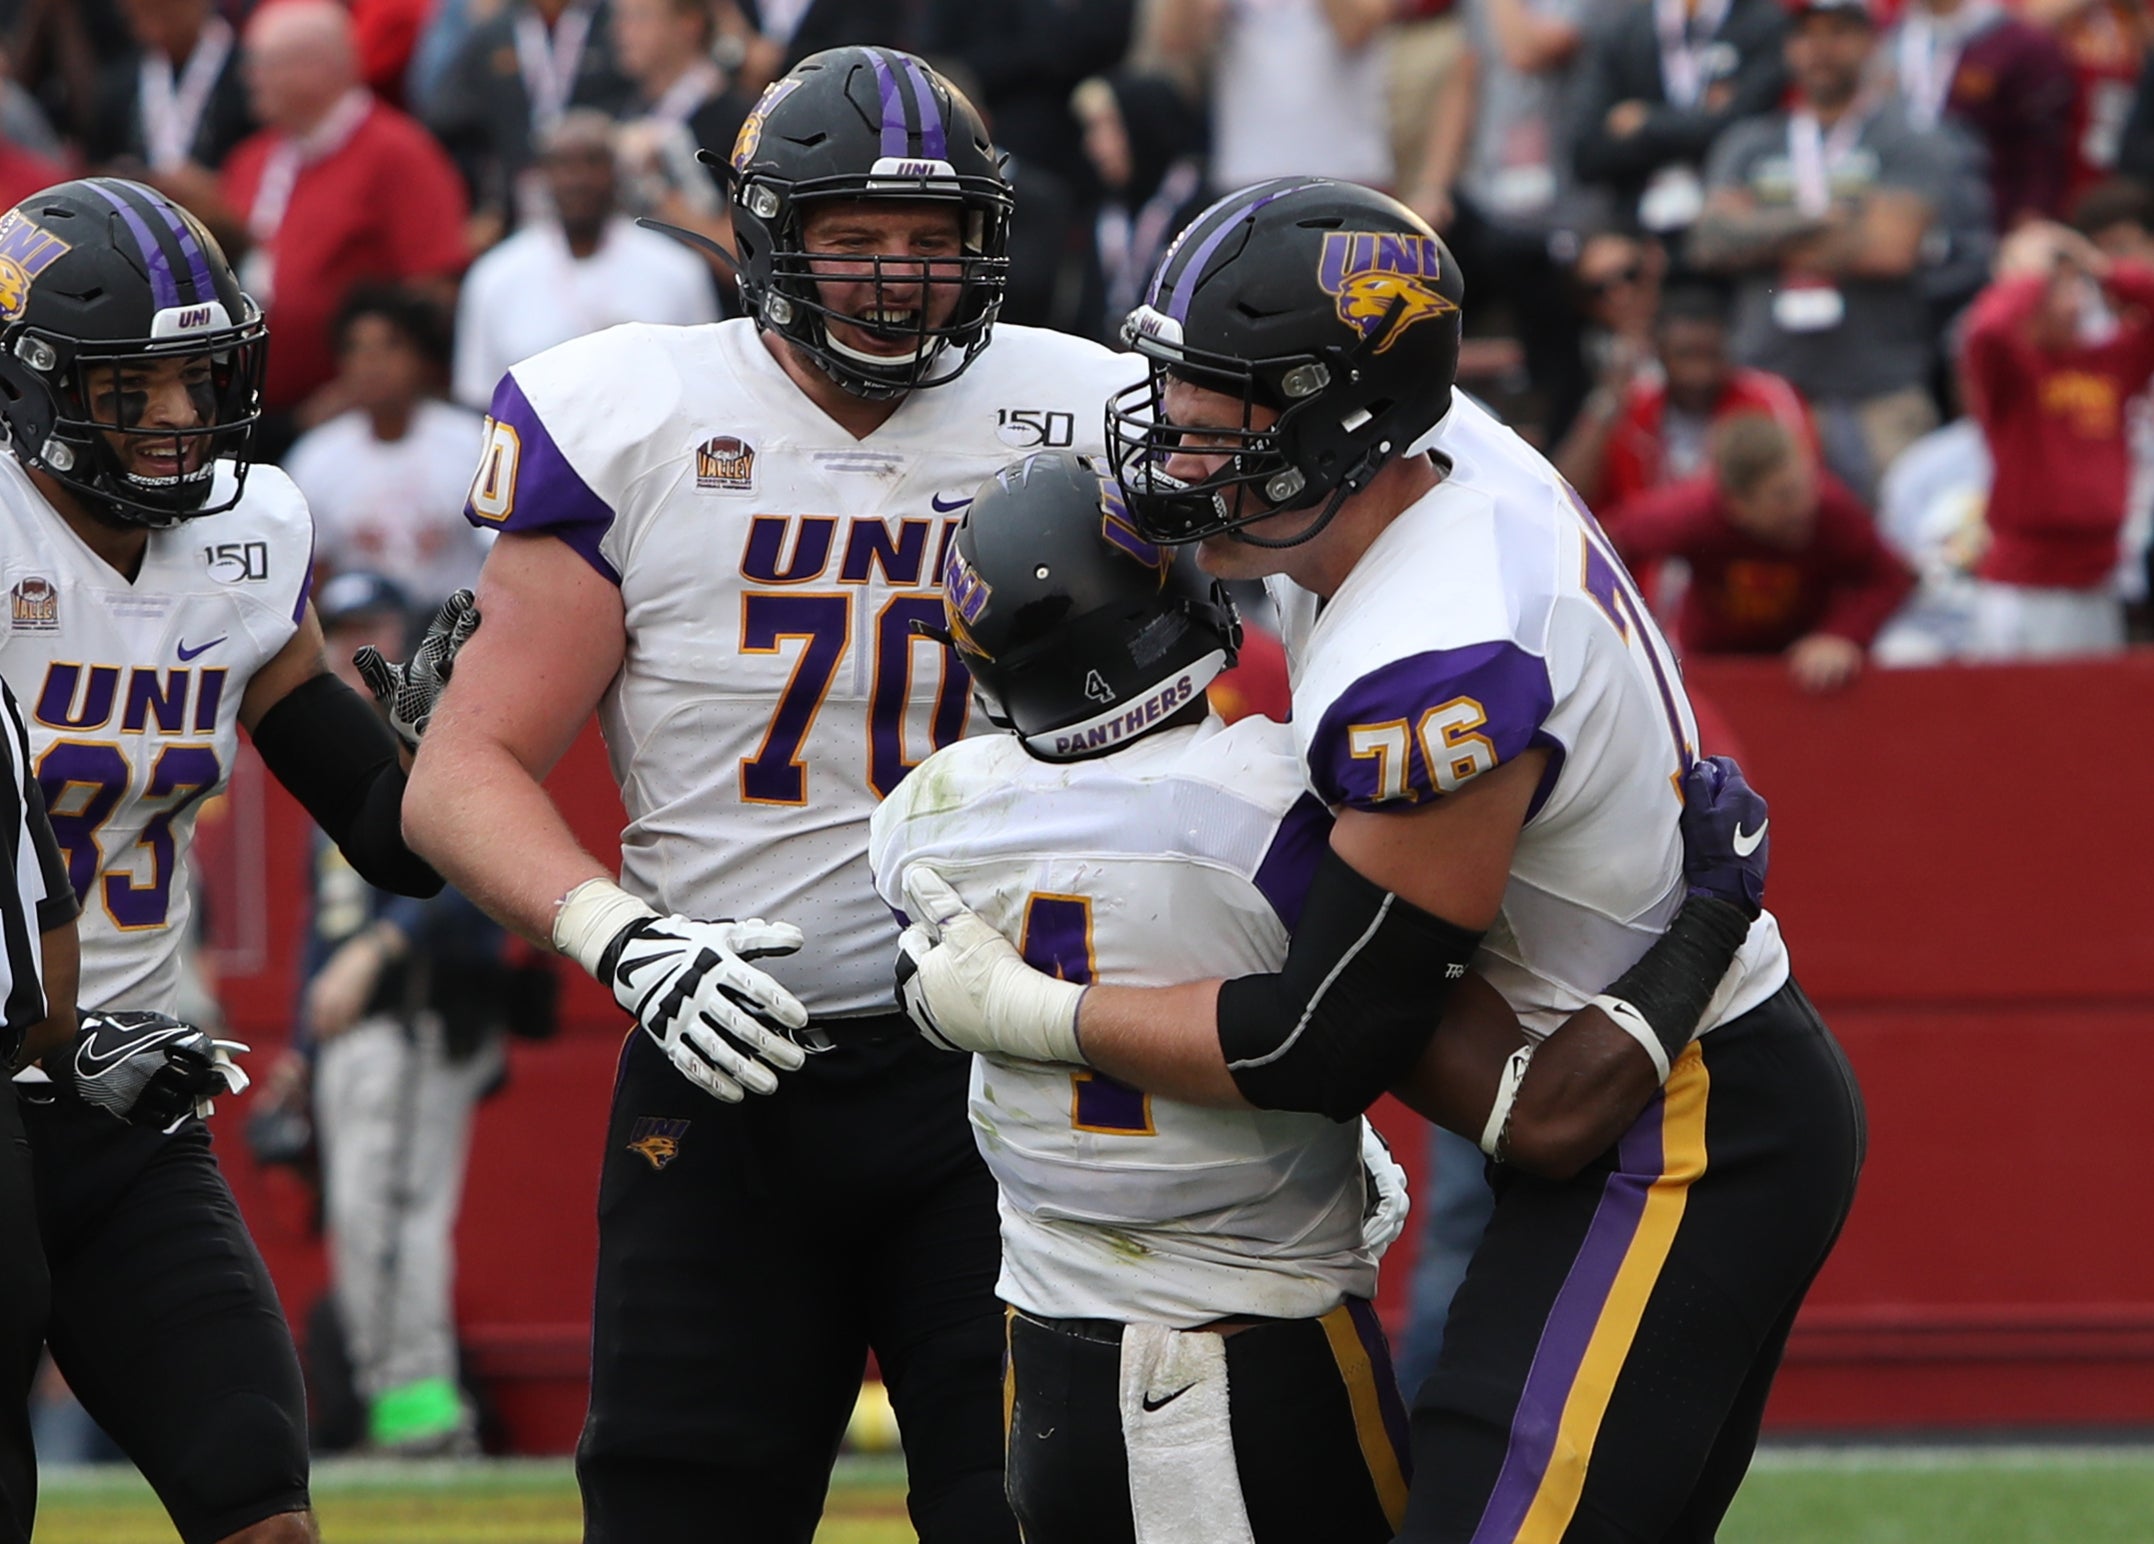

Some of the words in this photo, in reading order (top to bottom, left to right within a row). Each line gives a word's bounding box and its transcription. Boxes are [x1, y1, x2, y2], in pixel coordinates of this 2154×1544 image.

[0, 207, 72, 279] NI
[1317, 231, 1440, 296] UNI
[178, 307, 211, 329] UNI
[997, 408, 1075, 448] 150
[471, 414, 521, 522] 0
[696, 449, 755, 480] VALLEY
[203, 541, 268, 582] 150
[32, 659, 230, 736] UNI
[738, 590, 976, 806] 70
[1055, 675, 1193, 754] PANTHERS
[1085, 669, 1116, 704] 4
[1347, 695, 1499, 803] 76
[33, 737, 223, 933] 83
